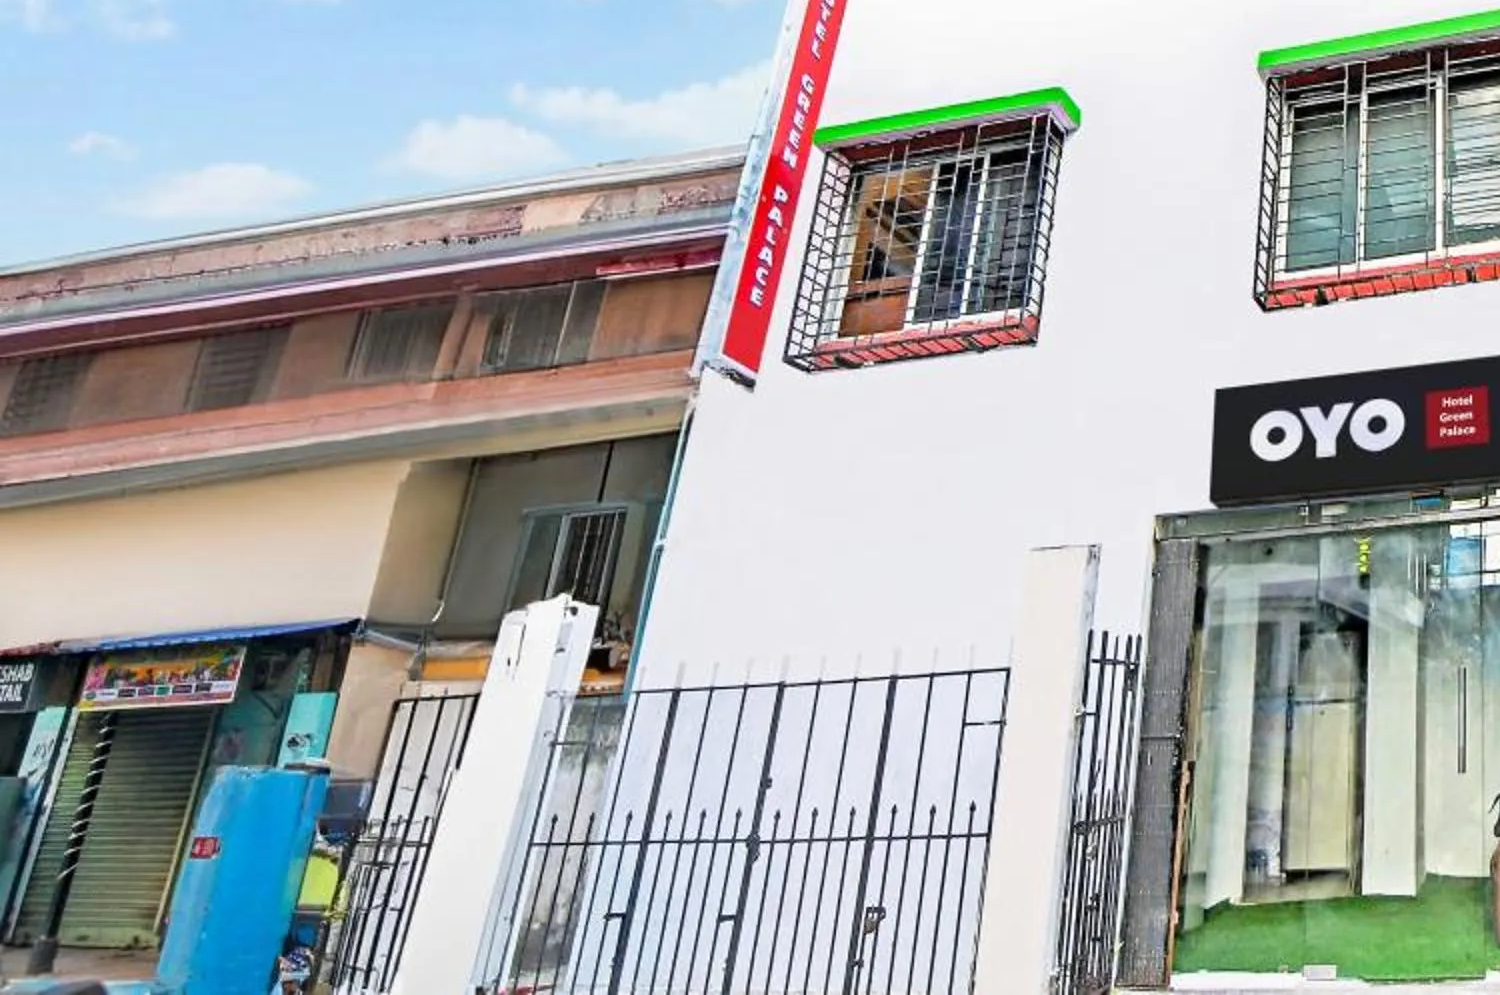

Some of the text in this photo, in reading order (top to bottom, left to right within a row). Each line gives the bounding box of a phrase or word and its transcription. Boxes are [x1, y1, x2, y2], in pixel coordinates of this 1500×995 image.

[782, 72, 815, 169] GREEN
[749, 184, 789, 308] PALACE
[1439, 412, 1473, 423] Green
[1441, 394, 1473, 407] Hotel
[1250, 398, 1405, 462] OYO
[1439, 426, 1476, 437] Palace
